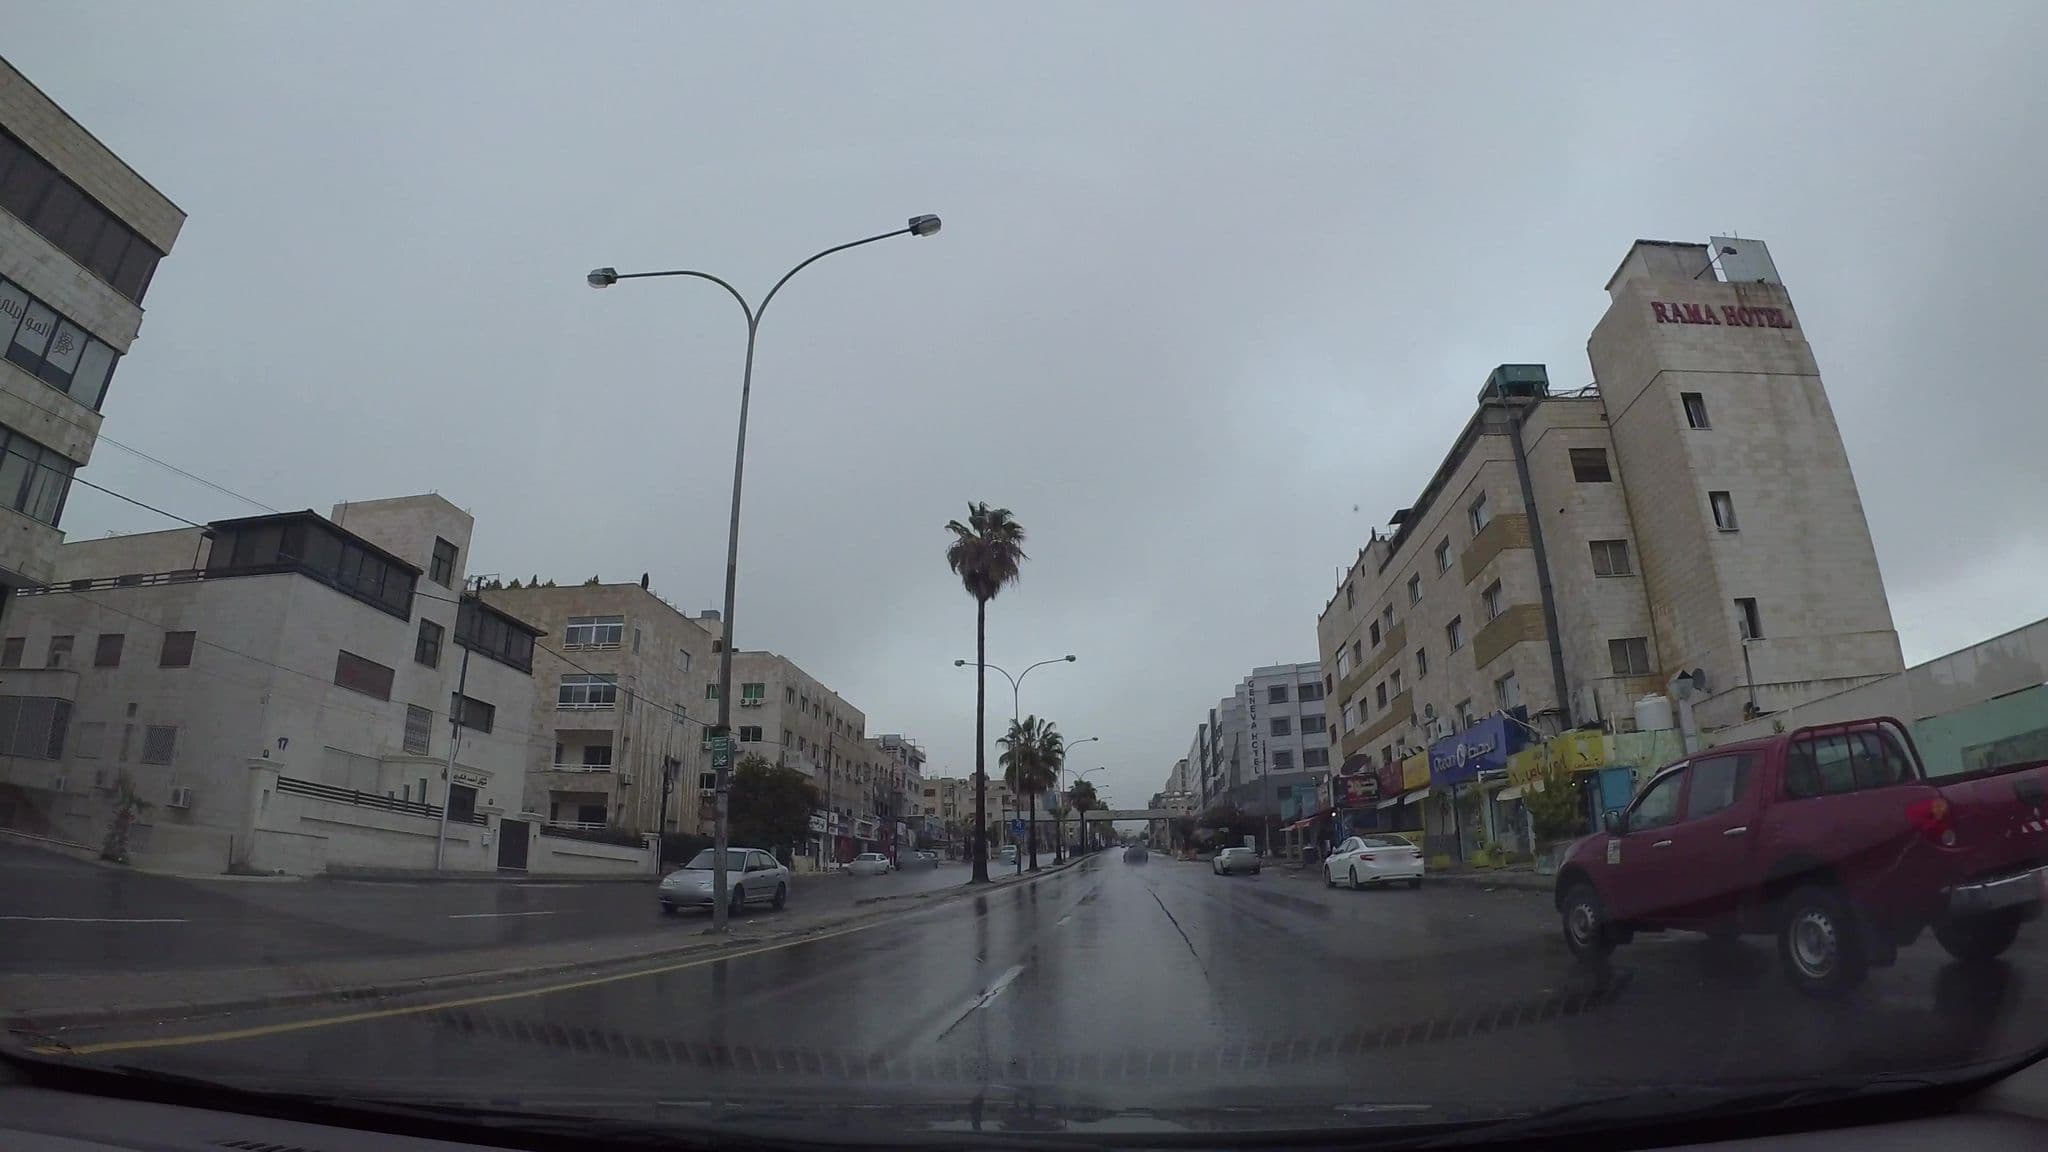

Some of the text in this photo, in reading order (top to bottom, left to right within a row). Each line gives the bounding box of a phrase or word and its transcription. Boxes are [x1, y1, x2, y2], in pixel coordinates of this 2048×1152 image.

[1651, 301, 1793, 329] RAMA HOTEL
[1247, 680, 1259, 774] GENEVA HOTEL
[277, 737, 289, 750] 17
